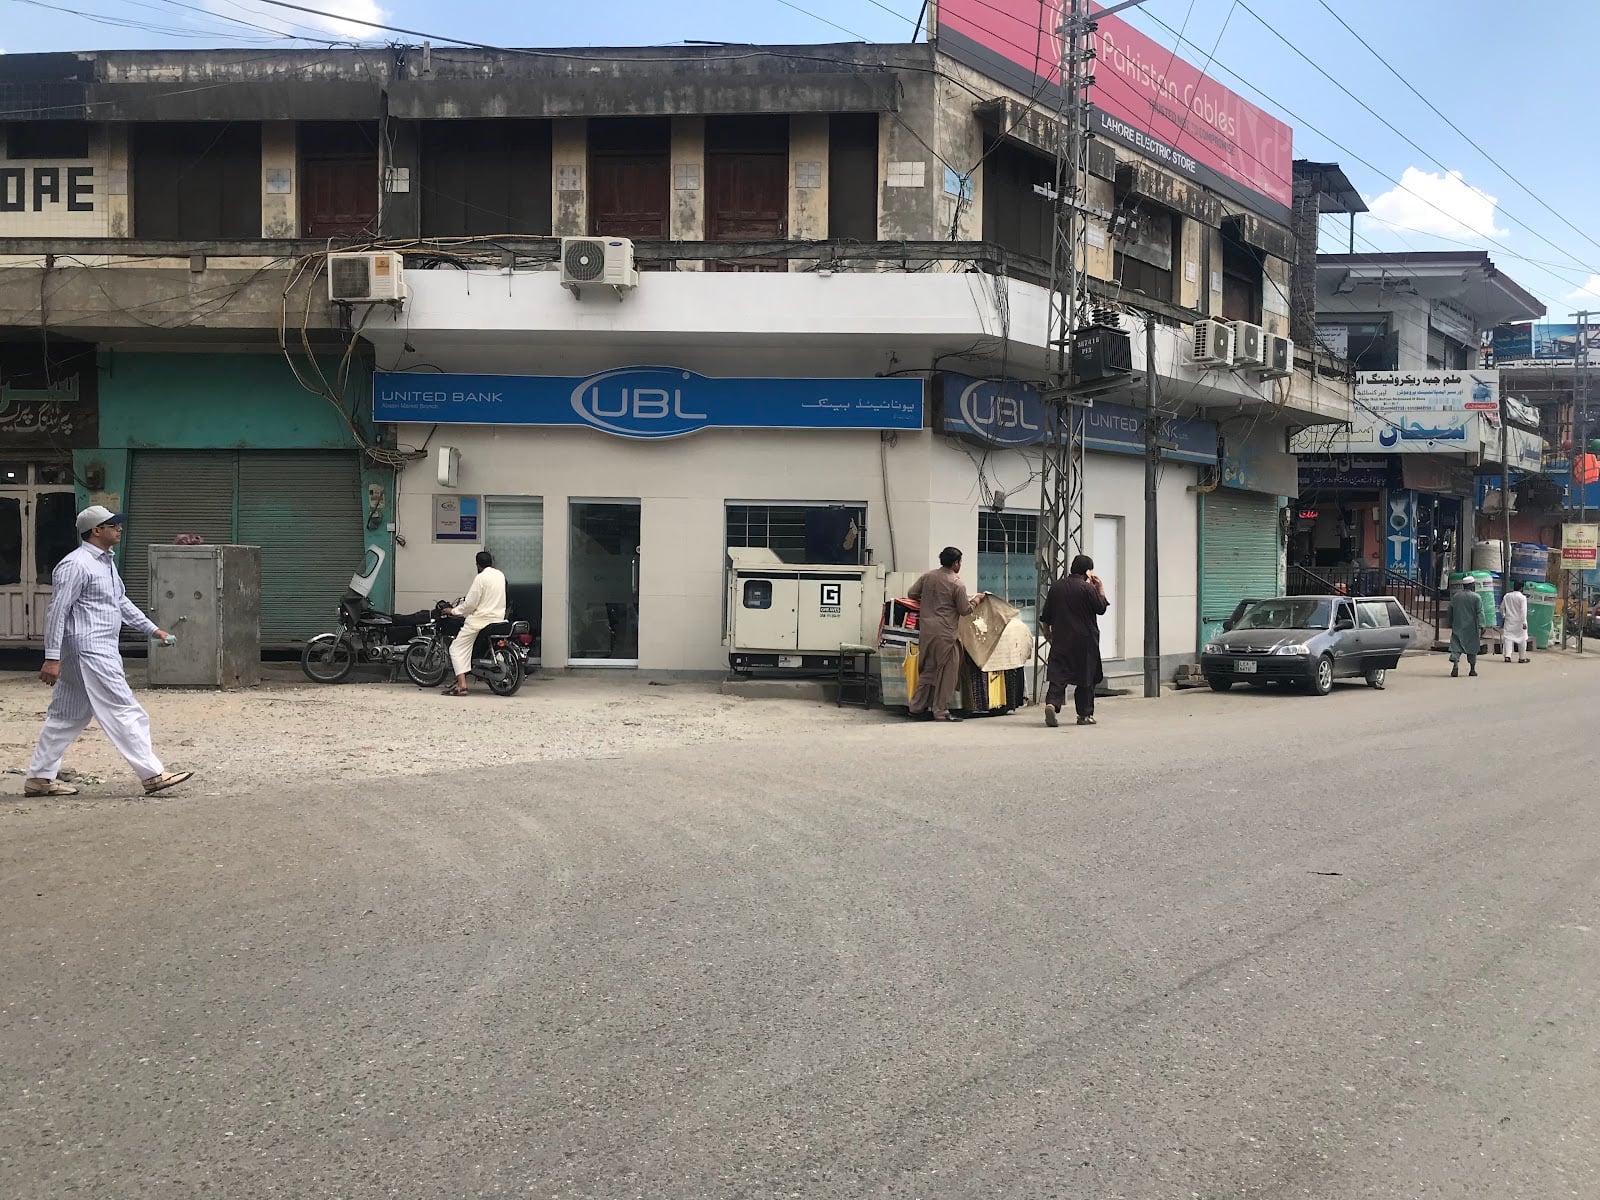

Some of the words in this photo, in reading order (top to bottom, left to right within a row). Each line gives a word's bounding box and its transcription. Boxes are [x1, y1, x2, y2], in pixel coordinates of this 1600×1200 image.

[1102, 31, 1178, 104] Pakistan
[1184, 84, 1235, 136] Cables
[1101, 114, 1134, 142] LAHORE
[1136, 131, 1172, 161] ELECTRIC
[1172, 151, 1196, 173] STORE
[381, 391, 447, 402] UNITED
[452, 392, 503, 403] BANK
[1443, 374, 1462, 387] ملم
[591, 385, 708, 420] UBL
[971, 391, 1038, 431] UBL
[1088, 412, 1139, 433] UNITED
